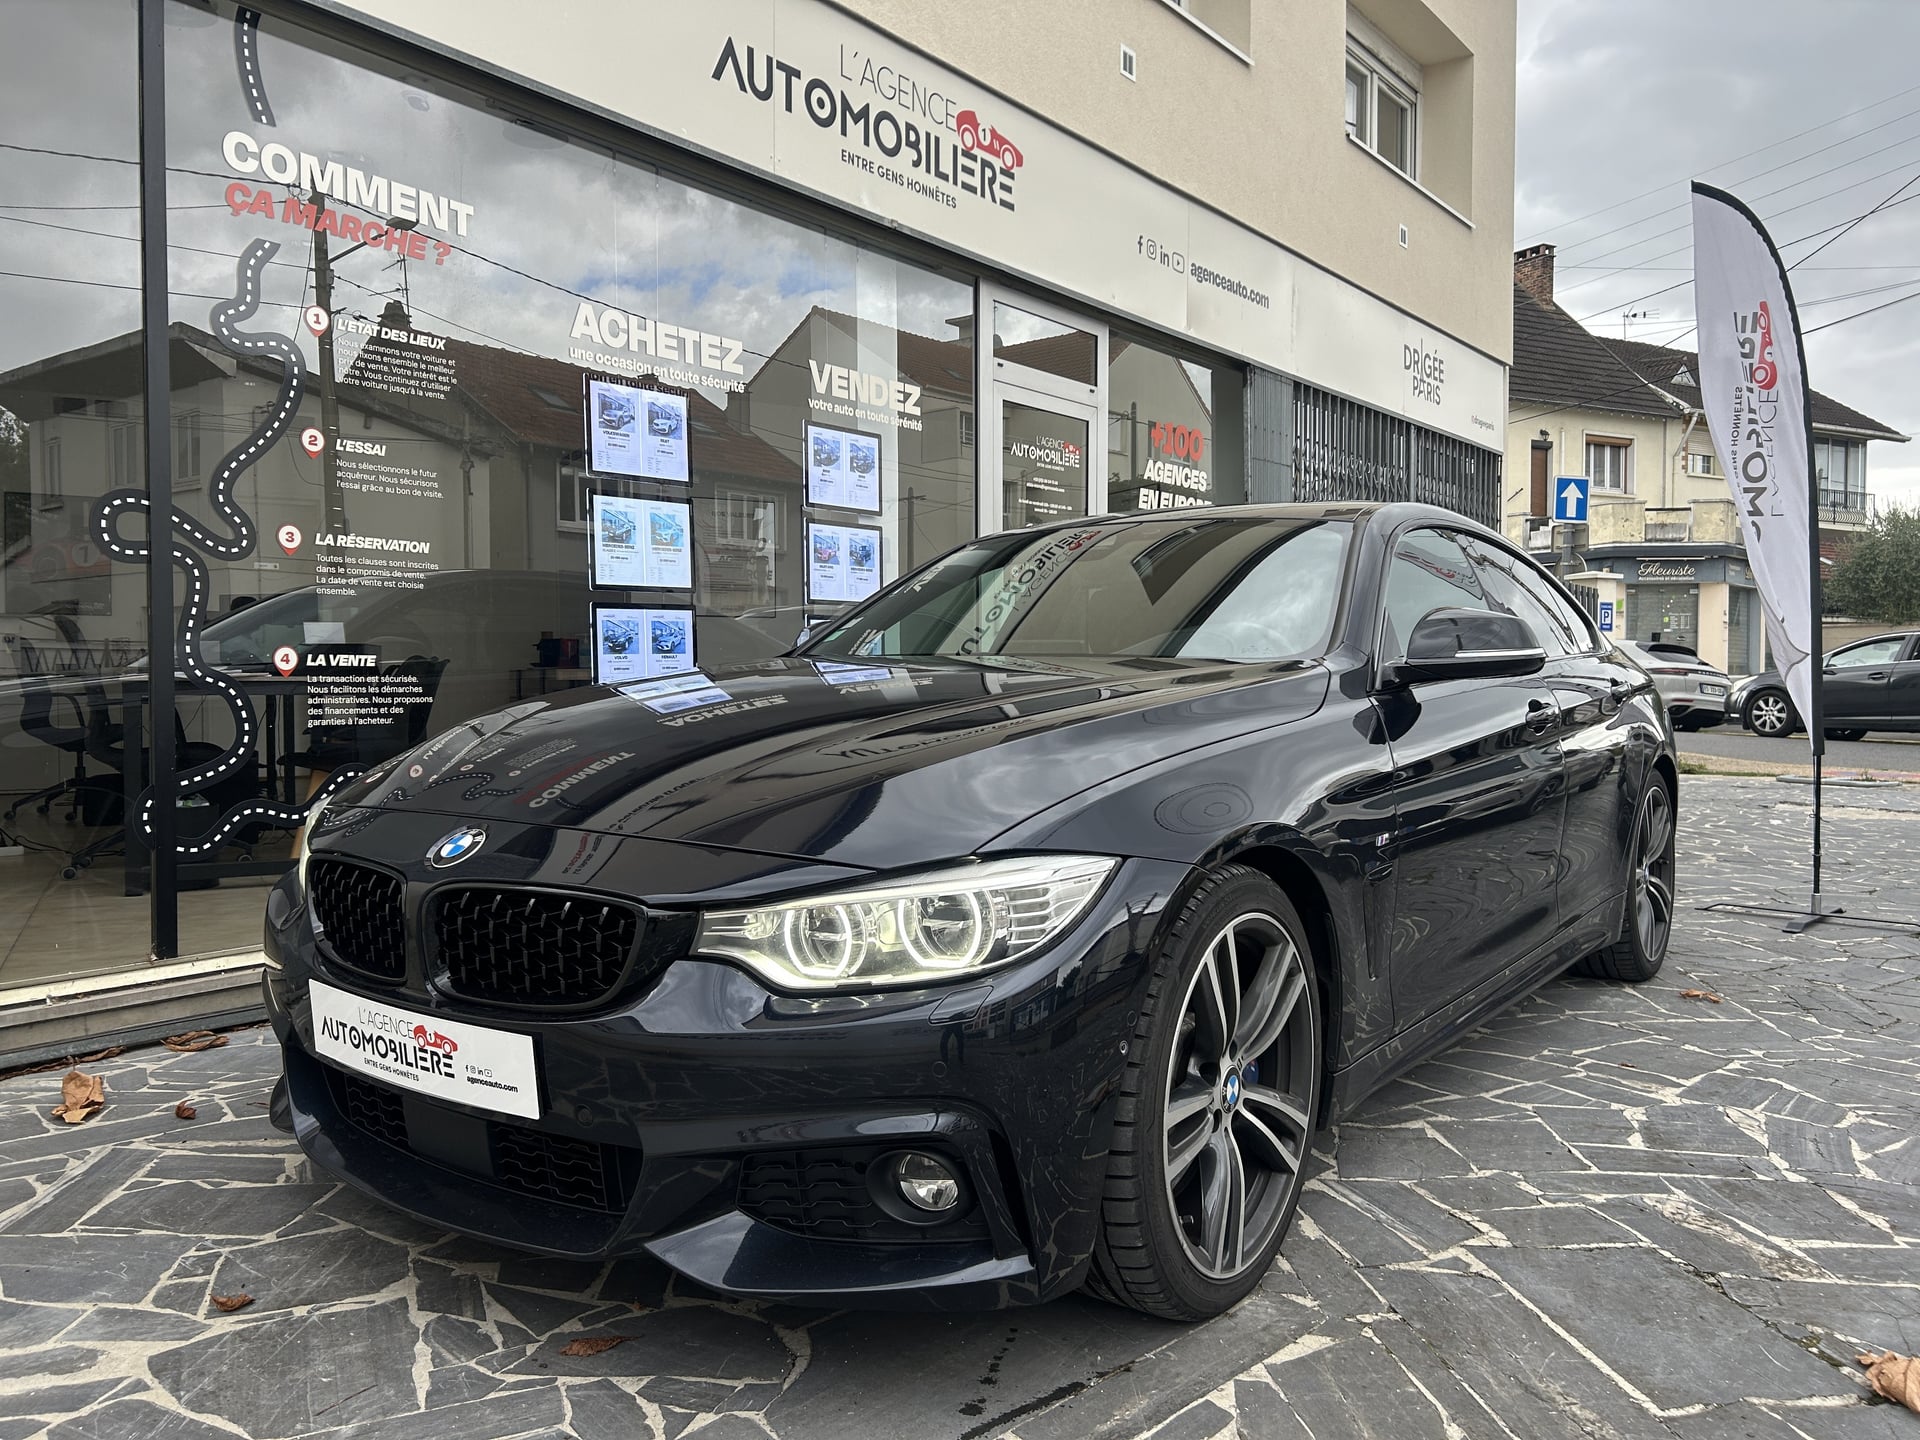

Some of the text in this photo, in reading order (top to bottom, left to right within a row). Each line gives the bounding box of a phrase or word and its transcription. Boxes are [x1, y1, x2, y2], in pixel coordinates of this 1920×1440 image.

[840, 44, 957, 132] L'AGENCE
[711, 36, 1015, 212] AUTOMOBILIERE
[981, 128, 987, 142] 1
[222, 131, 474, 237] COMMENT
[841, 149, 957, 209] ENTRE GENS HONNÊTES
[225, 182, 275, 219] ÇA
[282, 197, 427, 261] MARCHE
[1190, 262, 1270, 309] agenceauto.com
[313, 313, 322, 324] 1
[381, 327, 408, 343] DES
[410, 333, 446, 350] LIEUX
[570, 302, 744, 375] ACHETEZ
[338, 338, 456, 367] Nous examinons votre voiture et
[338, 348, 456, 375] nous fixons ensemble le meilleur
[338, 357, 458, 385] prix de vente. Votre intérêt est le
[569, 347, 593, 363] une
[595, 353, 652, 375] occasion
[653, 364, 668, 378] en
[669, 368, 700, 385] toute
[701, 373, 745, 394] sécurité
[362, 380, 388, 391] voiture
[389, 383, 415, 395] jusqu'à
[416, 387, 424, 396] la
[424, 390, 447, 400] vente.
[808, 359, 921, 417] VENDEZ
[1412, 375, 1441, 405] PARIS
[808, 398, 923, 432] votre auto en toute sérénité
[308, 435, 318, 446] 2
[335, 439, 387, 457] L'ESSAI
[1036, 435, 1064, 450] L'AGENCE
[1151, 421, 1204, 462] +100
[1011, 442, 1080, 468] AUTOMOBILIERE
[336, 459, 438, 478] Nous sélectionnons le futur
[1143, 459, 1207, 492] AGENCES
[336, 470, 439, 489] acquéreur. Nous sécurisons
[336, 479, 444, 499] l'essai grâce au bon de visite.
[1138, 488, 1160, 510] EN
[285, 531, 295, 543] 3
[314, 533, 431, 554] LA RÉSERVATION
[316, 554, 439, 570] Toutes les clauses sont inscrites
[316, 565, 426, 579] dans le compromis de vente.
[1638, 562, 1696, 576] Fleuriste
[316, 576, 424, 590] La date de vente est choisie
[316, 587, 357, 596] ensemble.
[1604, 611, 1609, 622] P
[280, 653, 291, 664] 4
[306, 654, 377, 667] LA VENTE
[307, 675, 317, 683] La
[319, 675, 365, 683] transaction
[380, 675, 419, 683] sécurisée.
[307, 686, 328, 694] Nous
[330, 685, 367, 694] facilitons
[380, 685, 423, 693] démarches
[307, 696, 371, 704] administratives.
[393, 696, 433, 706] proposons
[307, 707, 323, 715] des
[324, 707, 378, 715] financements
[389, 706, 404, 714] des
[307, 717, 394, 728] garanties à l'acheteur.
[358, 1006, 415, 1040] L'AGENCE
[321, 1015, 455, 1079] AUTOMOBILIERE
[466, 1075, 518, 1093] agenceauto.com
